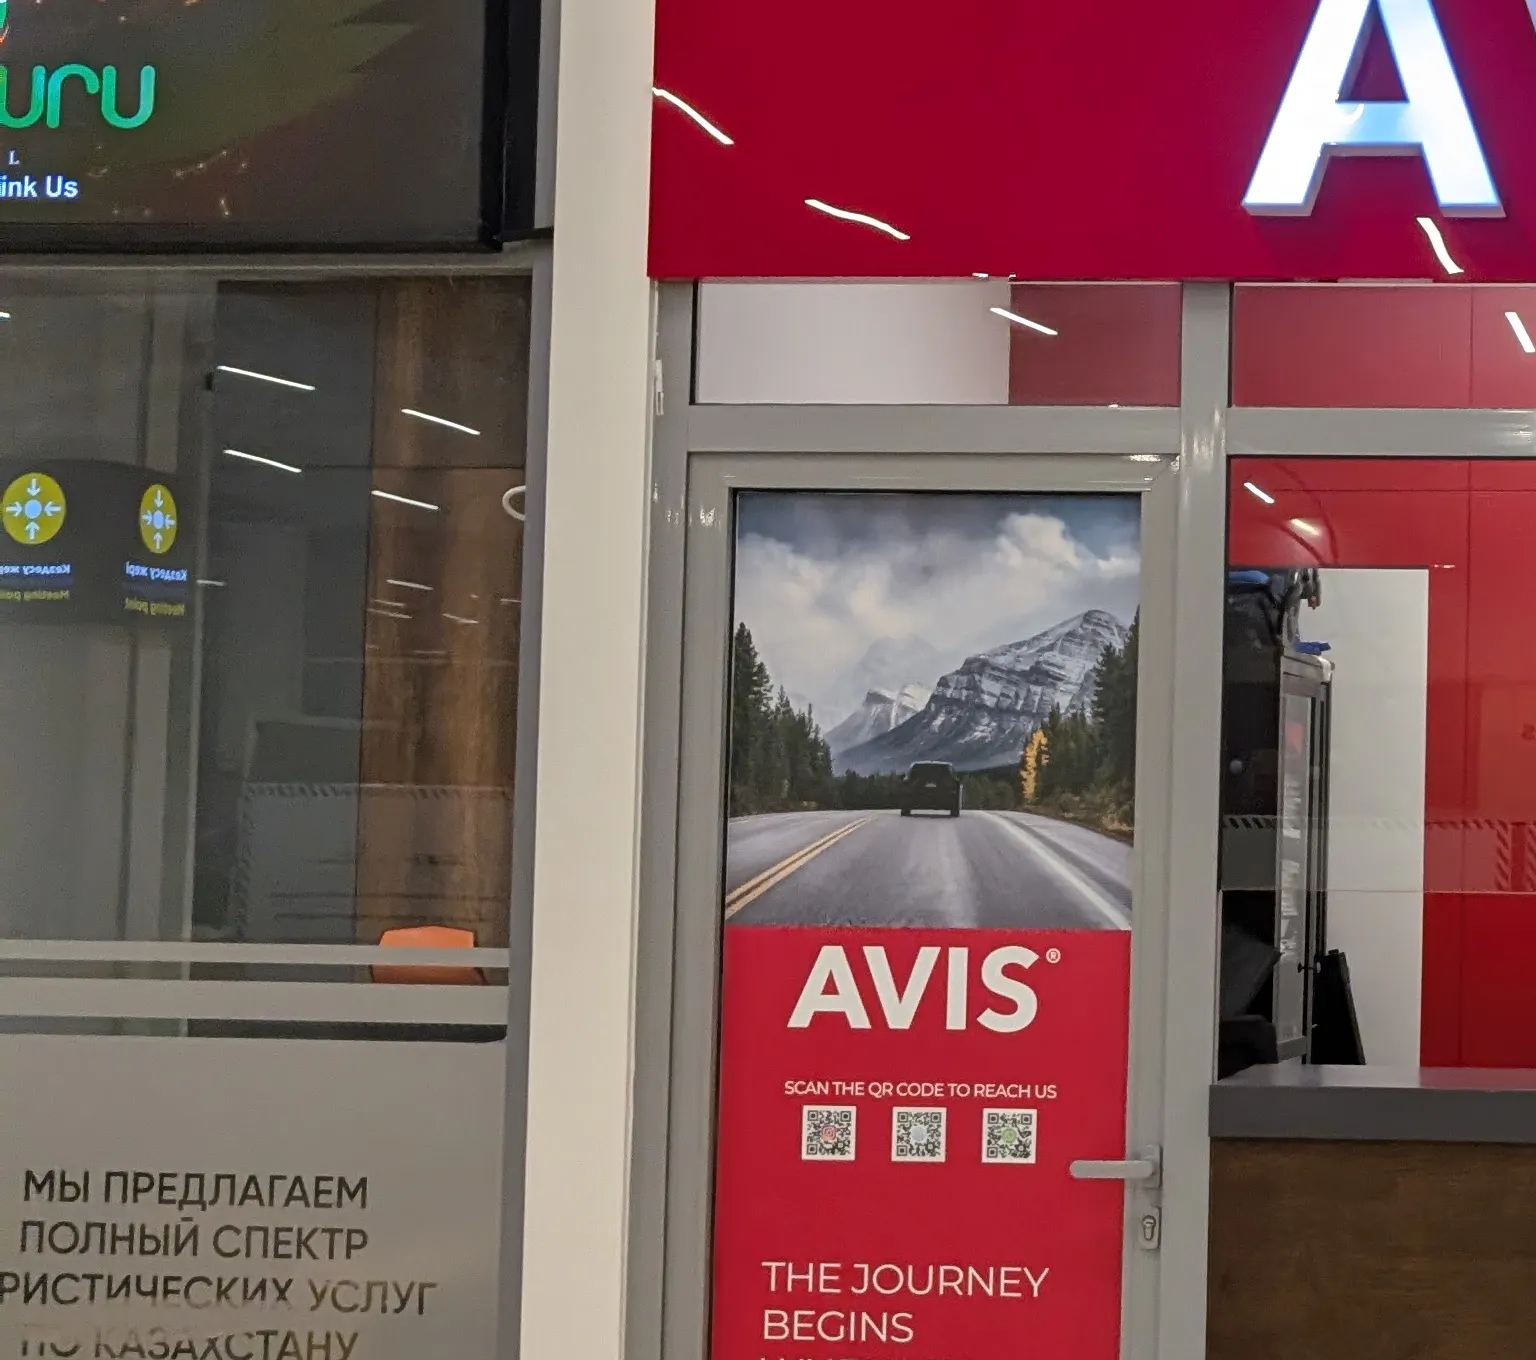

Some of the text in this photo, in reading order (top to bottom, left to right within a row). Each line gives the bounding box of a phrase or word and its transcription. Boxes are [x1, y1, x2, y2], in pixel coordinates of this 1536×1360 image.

[46, 175, 79, 198] Us
[784, 1080, 1058, 1100] SCAN THE QR CODE TO REACH US
[23, 1169, 368, 1212] МЫ ПРЕДЛАГАЕМ
[20, 1217, 369, 1260] ПОЛНЫЙ СПЕКТР
[307, 1279, 438, 1316] УСЛУГ
[761, 1261, 1050, 1298] THE JOURNEY
[763, 1309, 914, 1343] BEGINS
